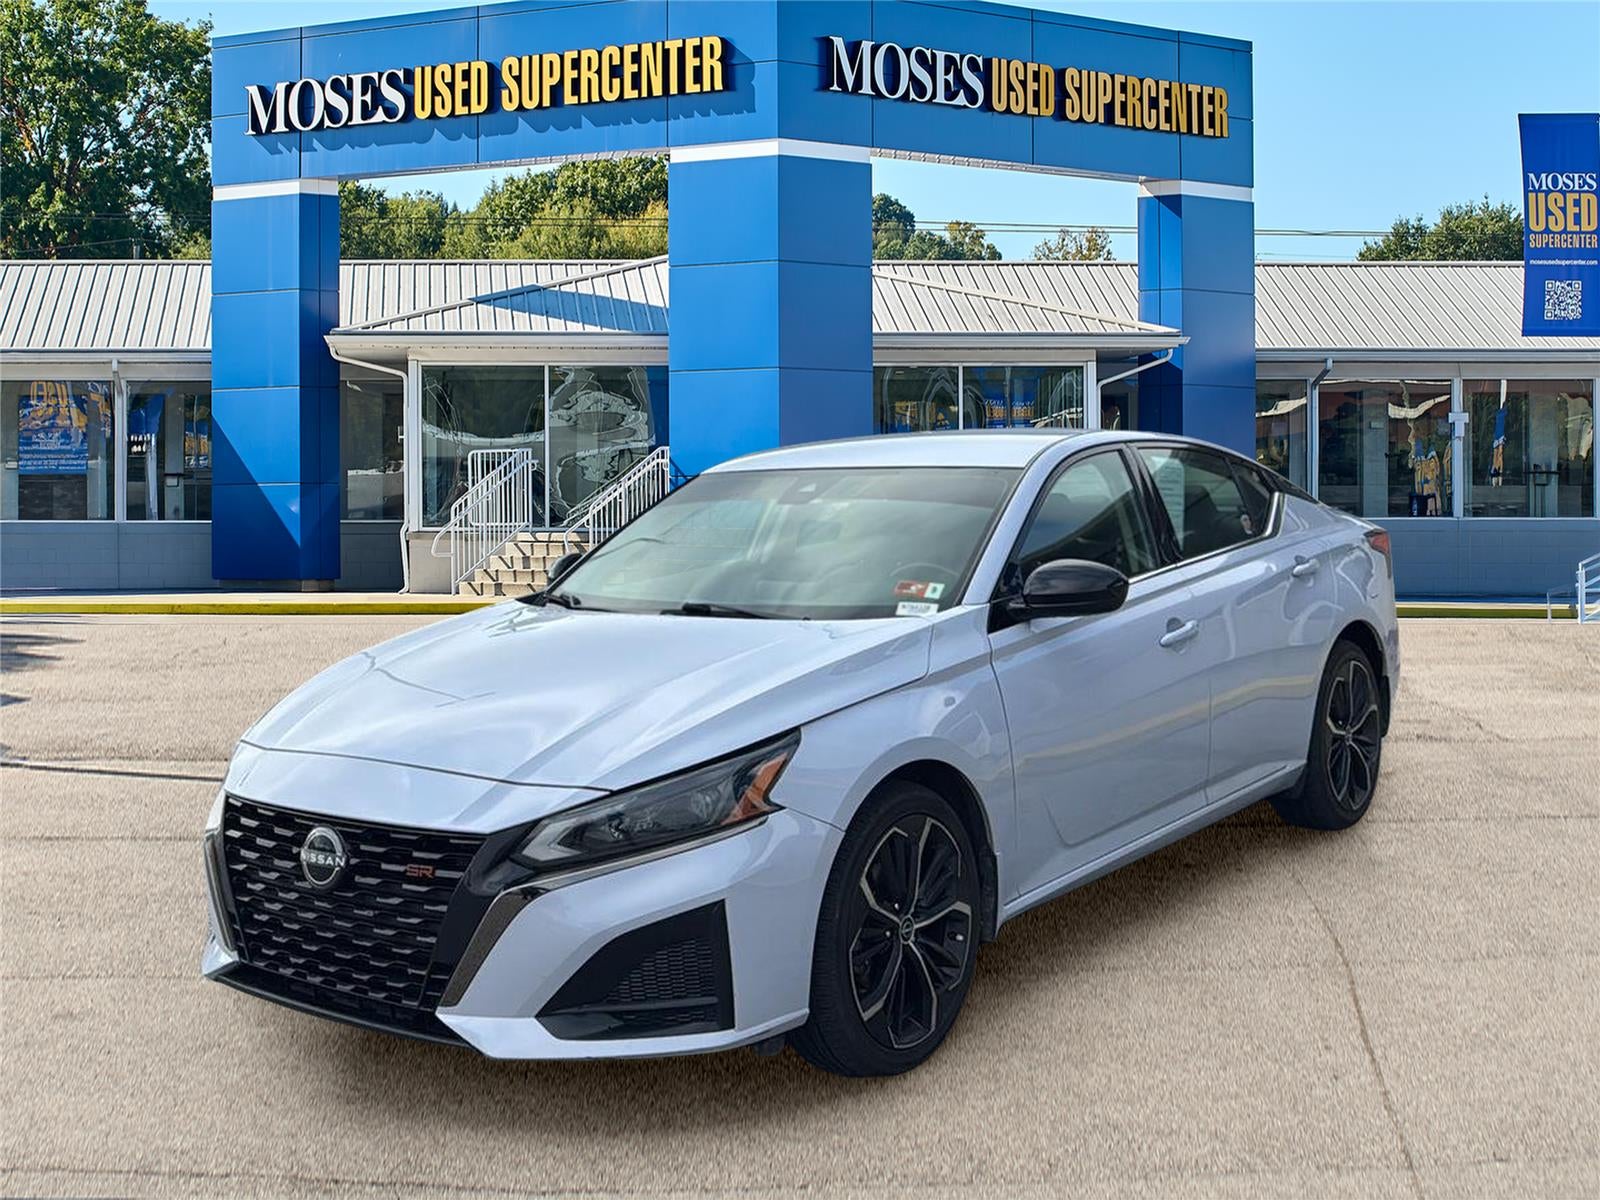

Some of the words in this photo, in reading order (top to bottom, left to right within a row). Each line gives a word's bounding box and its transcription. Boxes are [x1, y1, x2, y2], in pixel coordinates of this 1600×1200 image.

[244, 68, 408, 137] MOSES
[413, 61, 489, 120] USED
[501, 35, 724, 111] SUPERCENTER
[828, 35, 984, 108] MOSES
[991, 57, 1056, 117] USED
[1064, 66, 1230, 138] SUPERCENTER
[1527, 172, 1598, 192] MOSES
[1528, 192, 1599, 232] USED
[1529, 233, 1598, 249] SUPERCENTER
[301, 850, 346, 867] NISSAN
[405, 863, 434, 879] SR
